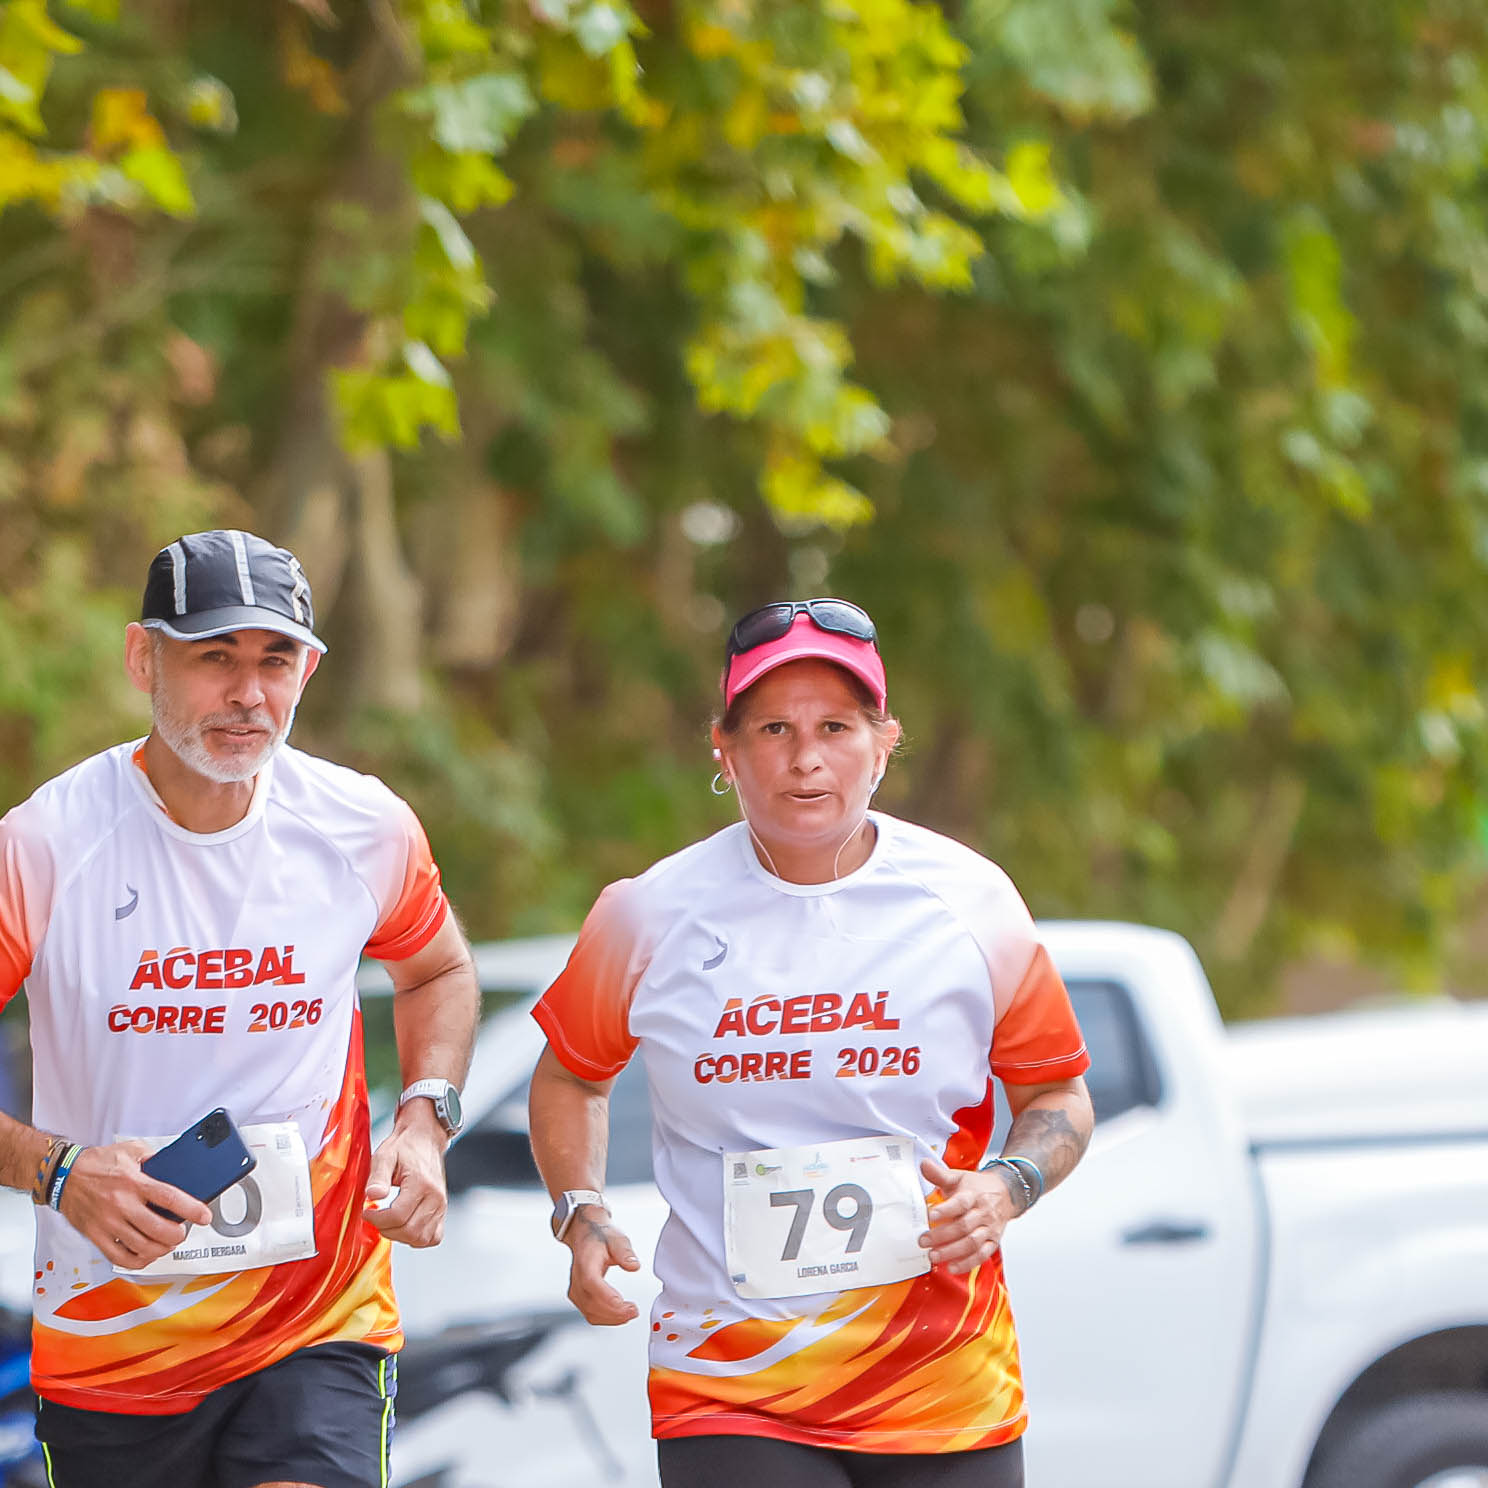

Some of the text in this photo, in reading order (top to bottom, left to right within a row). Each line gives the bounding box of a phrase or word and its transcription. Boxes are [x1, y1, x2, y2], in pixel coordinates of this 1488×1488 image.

[129, 945, 306, 991] ACEBAL
[107, 998, 324, 1034] CORRE 2026
[713, 991, 901, 1039] ACEBAL
[694, 1046, 921, 1084] CORRE 2026
[184, 1174, 262, 1238] 0
[769, 1183, 873, 1261] 79
[172, 1249, 209, 1261] MARCELO
[797, 1265, 828, 1278] LORENA
